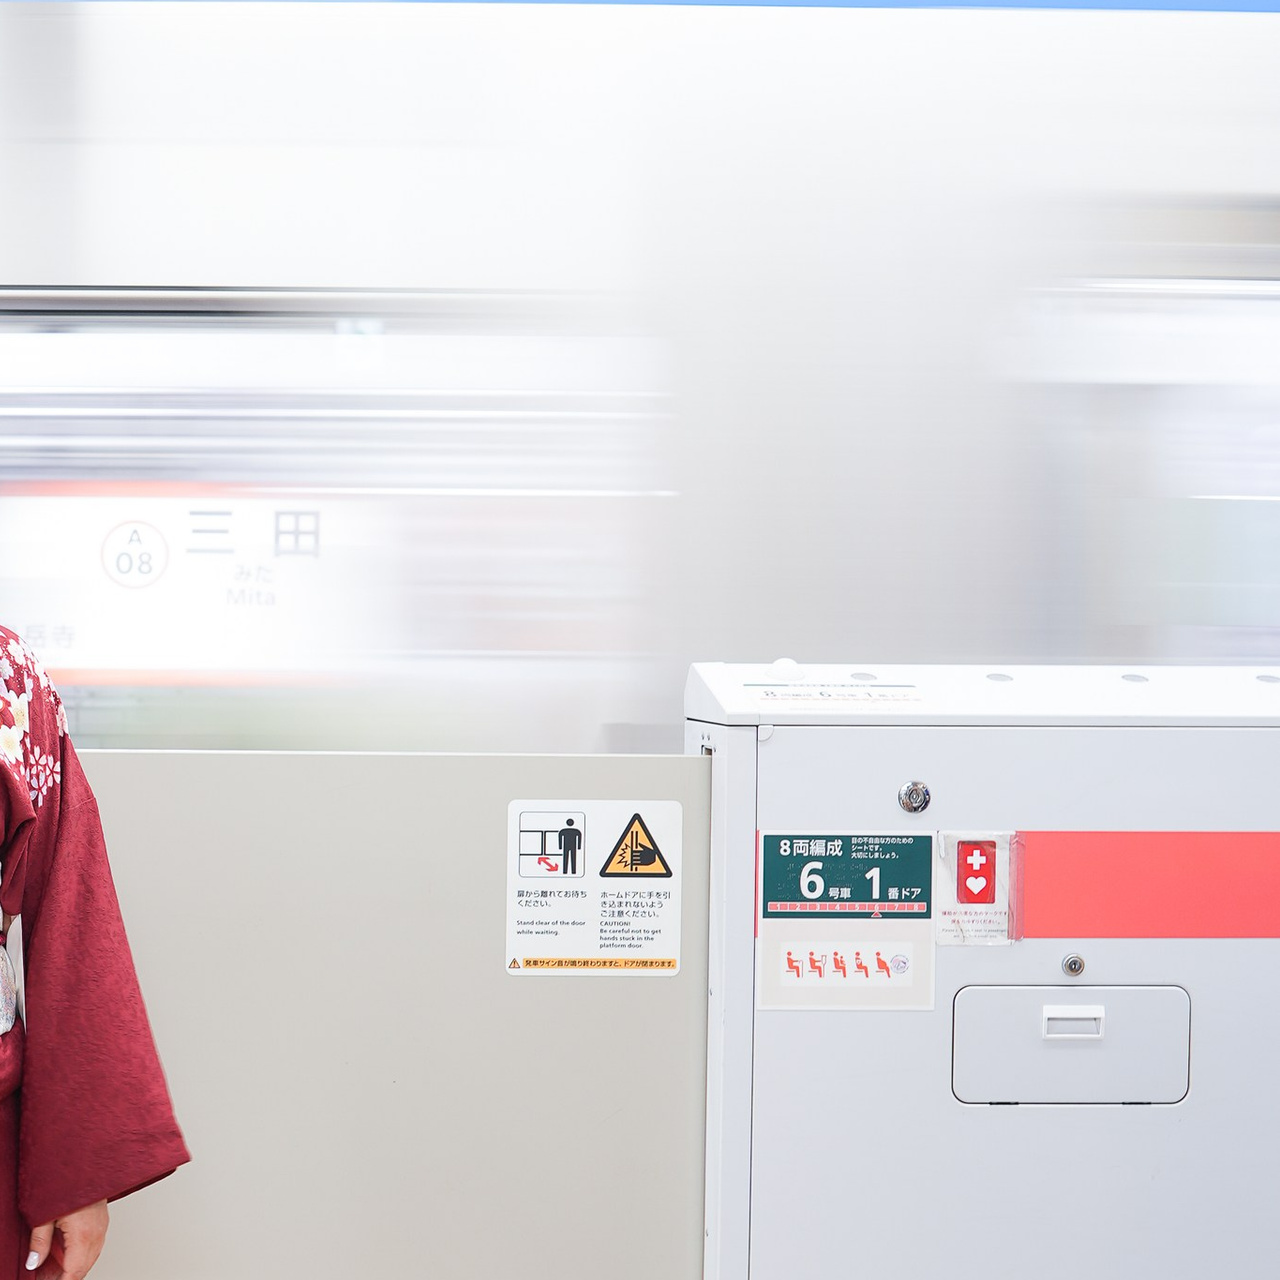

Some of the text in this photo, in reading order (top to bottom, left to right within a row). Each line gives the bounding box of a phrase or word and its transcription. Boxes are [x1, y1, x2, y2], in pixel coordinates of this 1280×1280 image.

[128, 529, 142, 545] A
[185, 510, 321, 558] 三田
[116, 552, 153, 575] 08
[233, 564, 275, 584] みた
[225, 587, 277, 607] Mita
[779, 839, 843, 857] 8両編成
[517, 890, 587, 898] 扉から離れてお待ち
[600, 891, 671, 899] ホームドアに手を引
[600, 901, 664, 909] き込まれないよう
[600, 910, 659, 918] ご注意ください。
